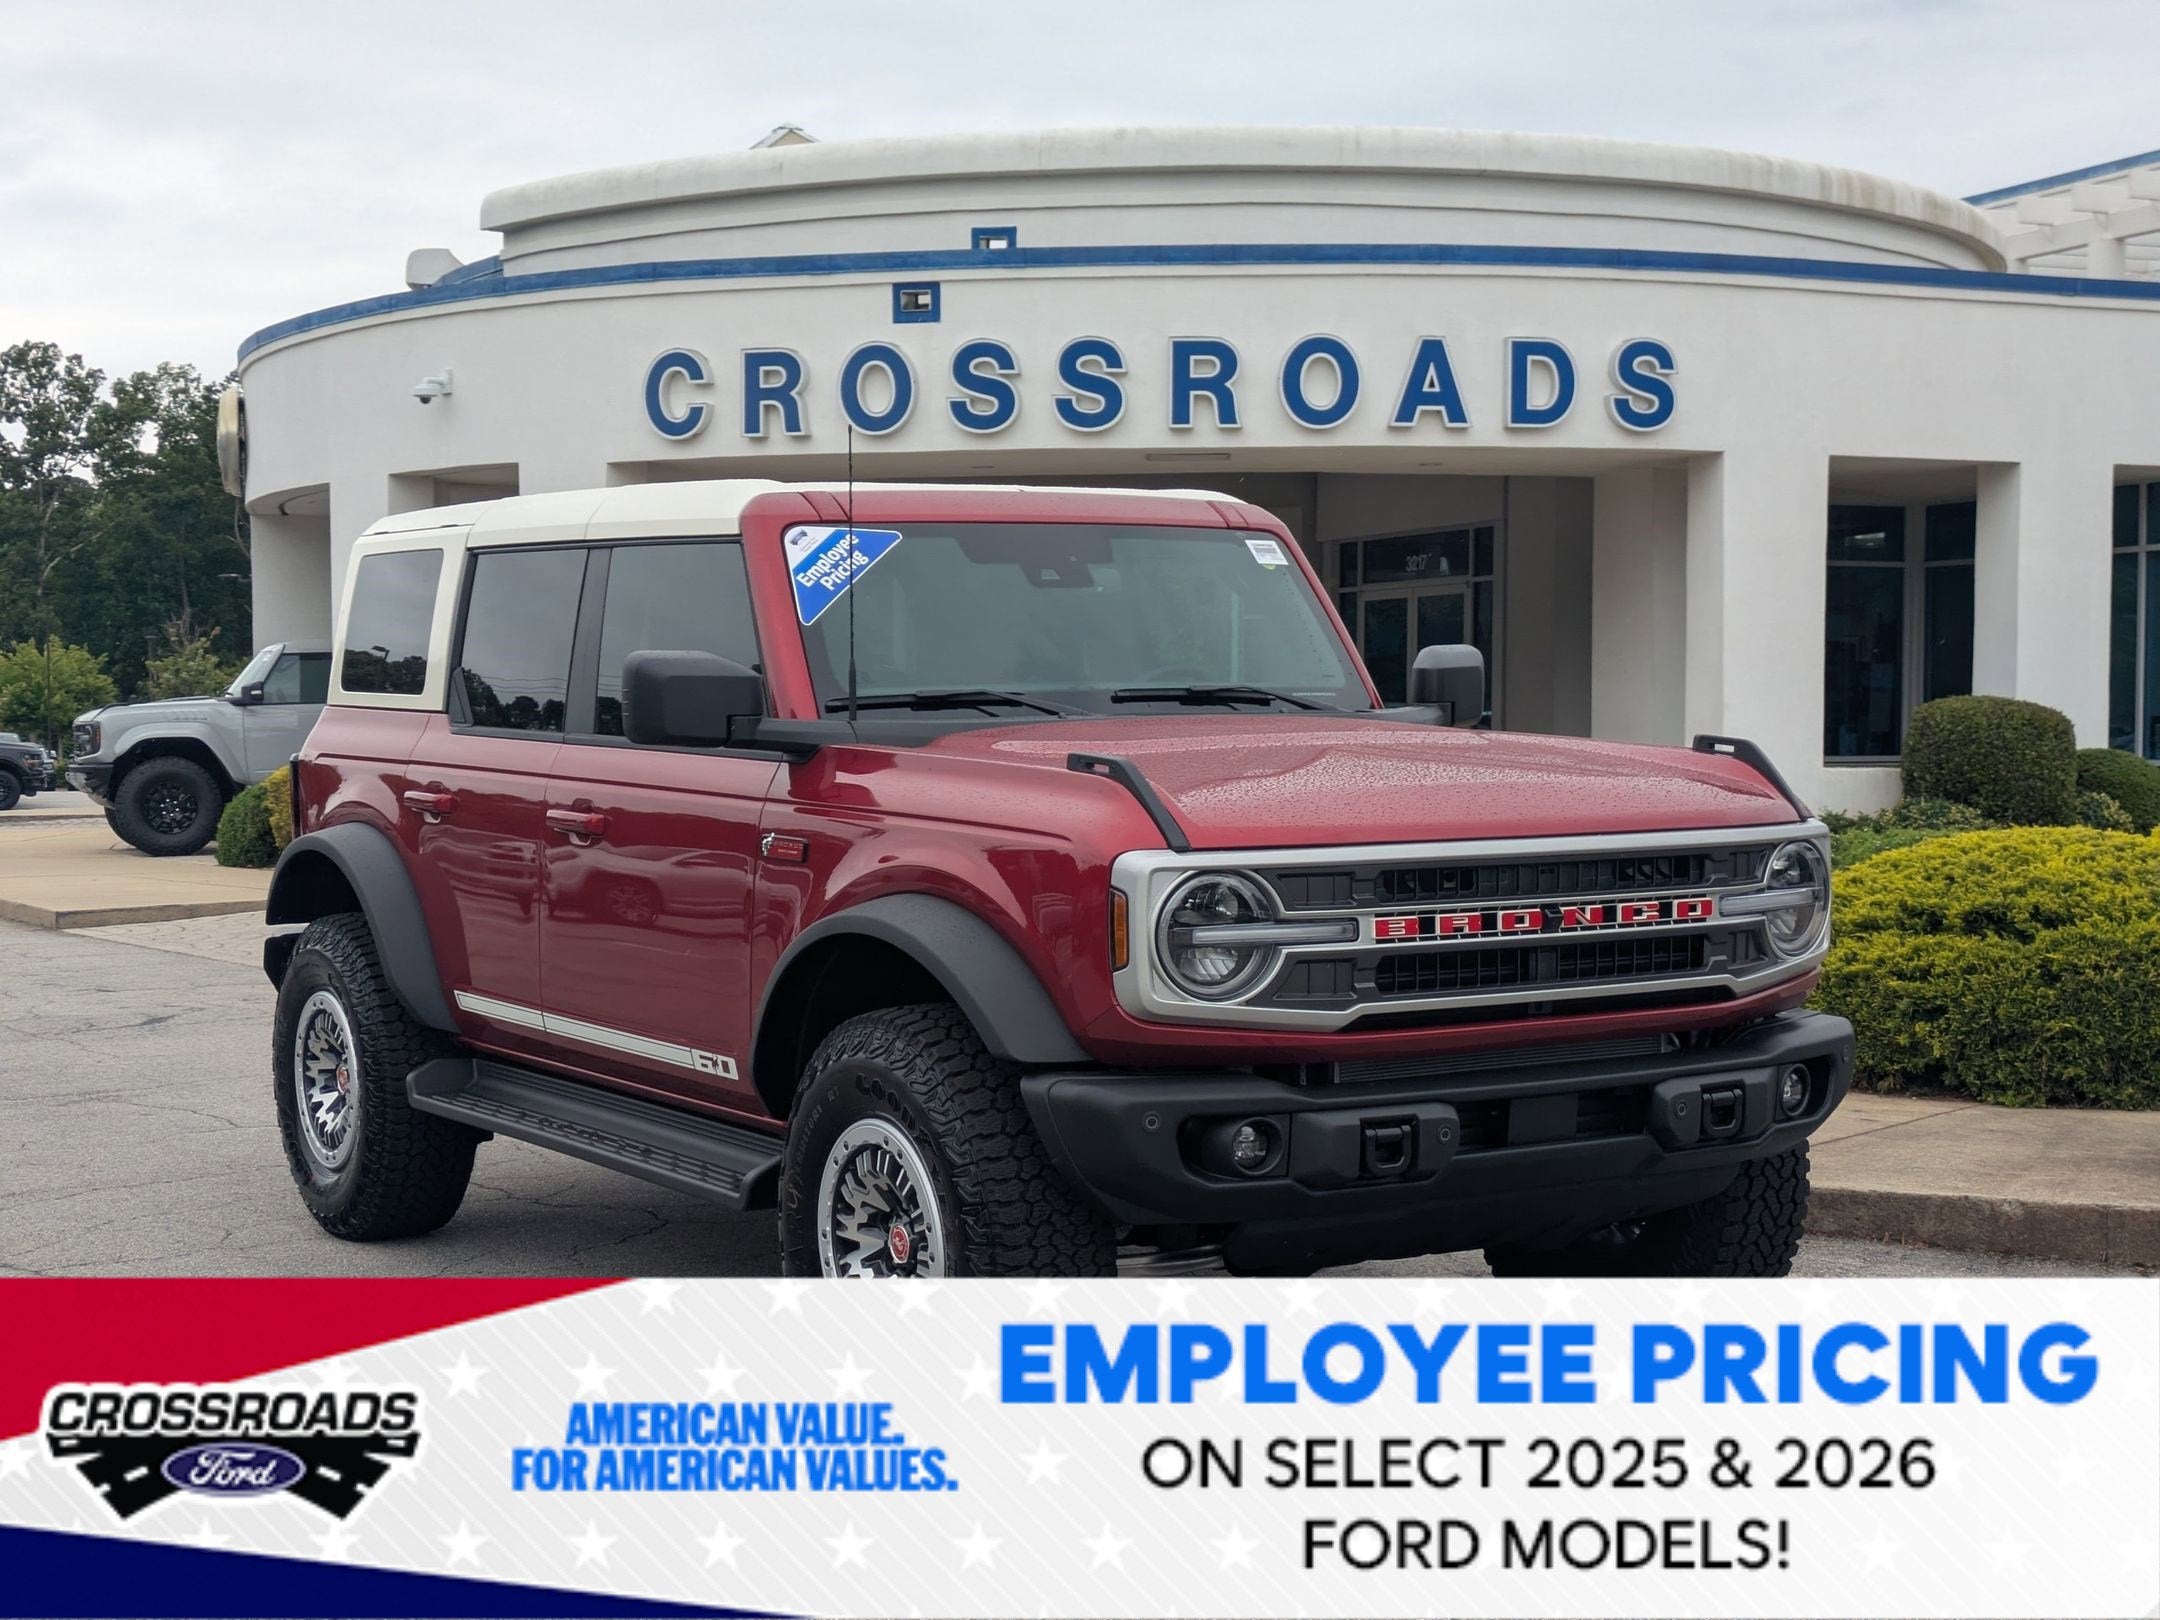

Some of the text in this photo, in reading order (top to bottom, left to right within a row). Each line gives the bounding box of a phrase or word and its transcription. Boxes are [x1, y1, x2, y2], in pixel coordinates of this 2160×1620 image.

[645, 334, 1679, 440] CROSSROADS
[797, 534, 859, 587] Employee
[820, 550, 869, 590] Pricing
[1373, 899, 1713, 938] BRONCO
[690, 1048, 739, 1080] 60
